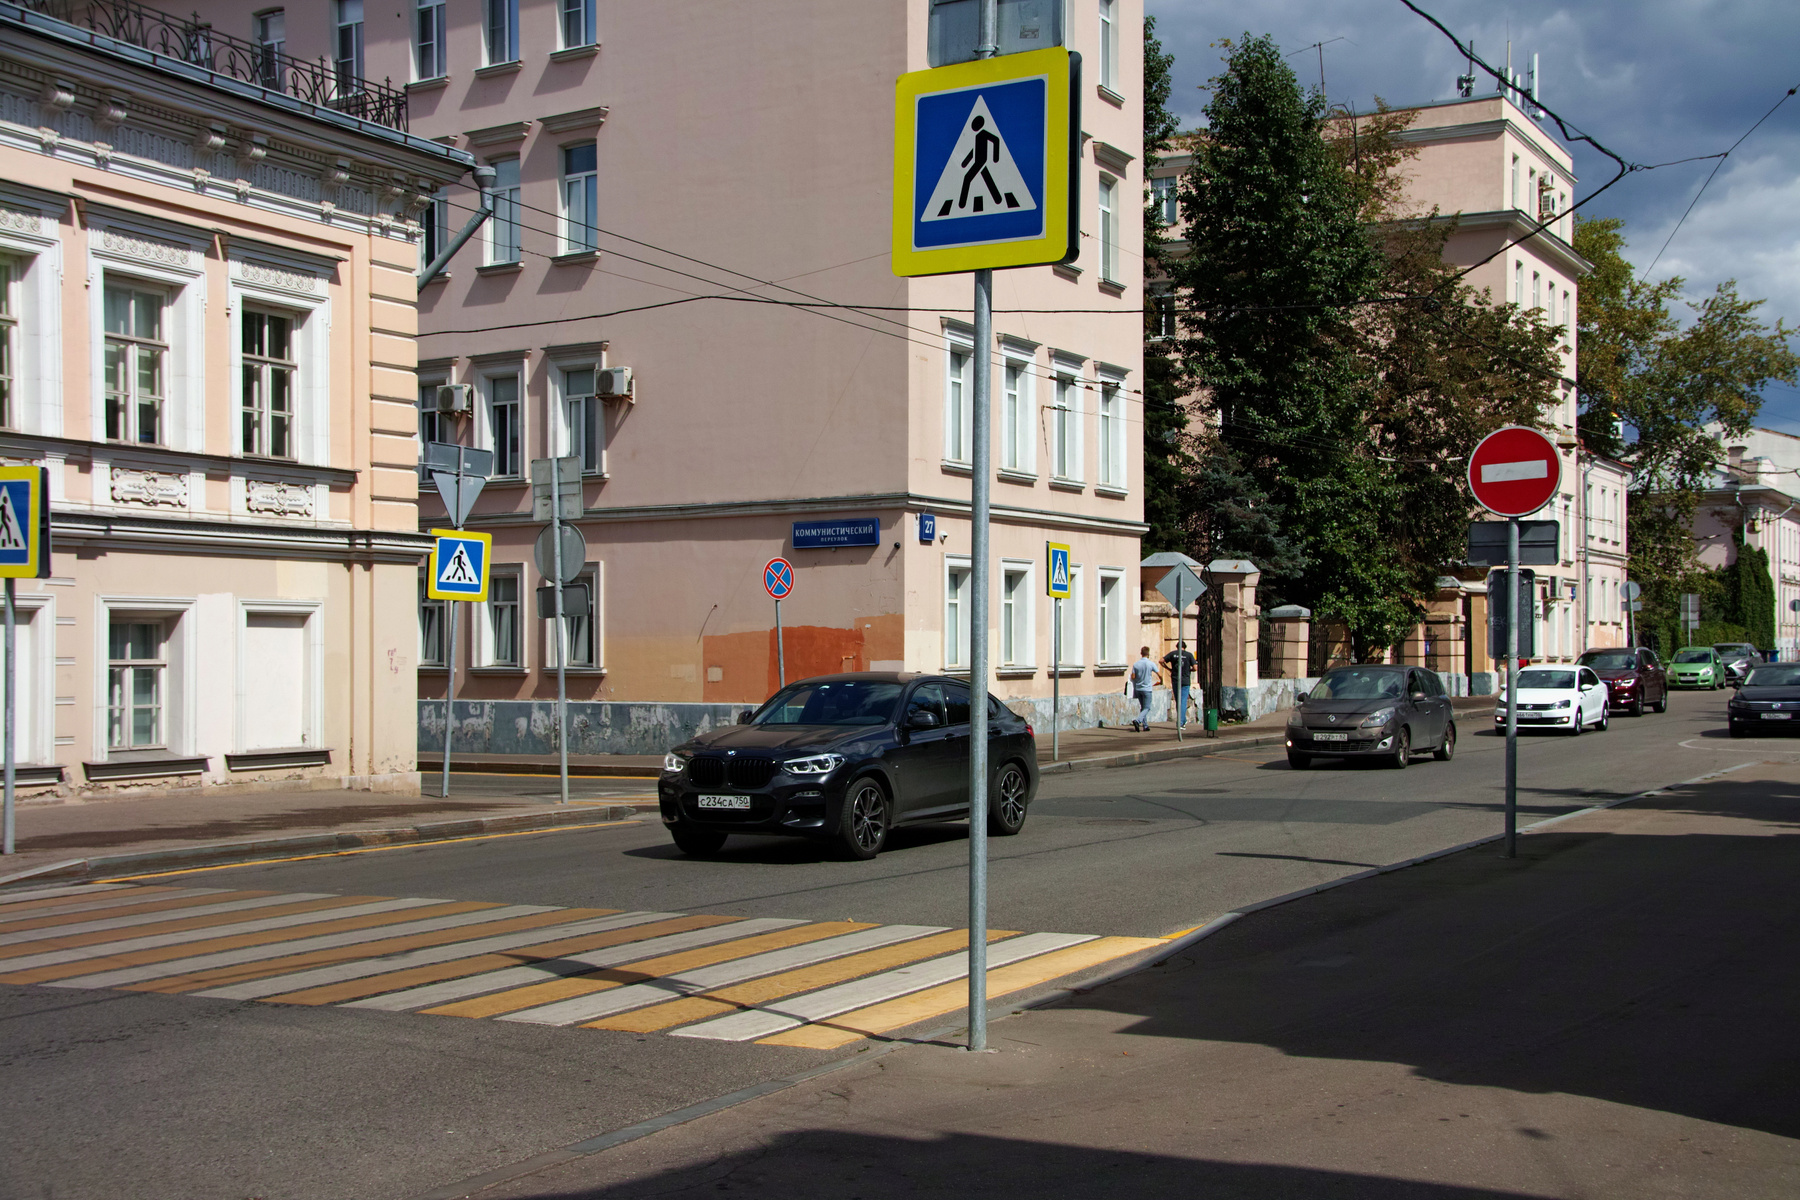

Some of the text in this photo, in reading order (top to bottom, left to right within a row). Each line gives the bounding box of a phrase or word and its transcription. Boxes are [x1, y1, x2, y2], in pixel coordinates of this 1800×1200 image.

[795, 524, 873, 537] КОММУНИСТИЧЕСКИЙ
[924, 520, 934, 534] 27
[700, 796, 749, 807] С234СА 750
